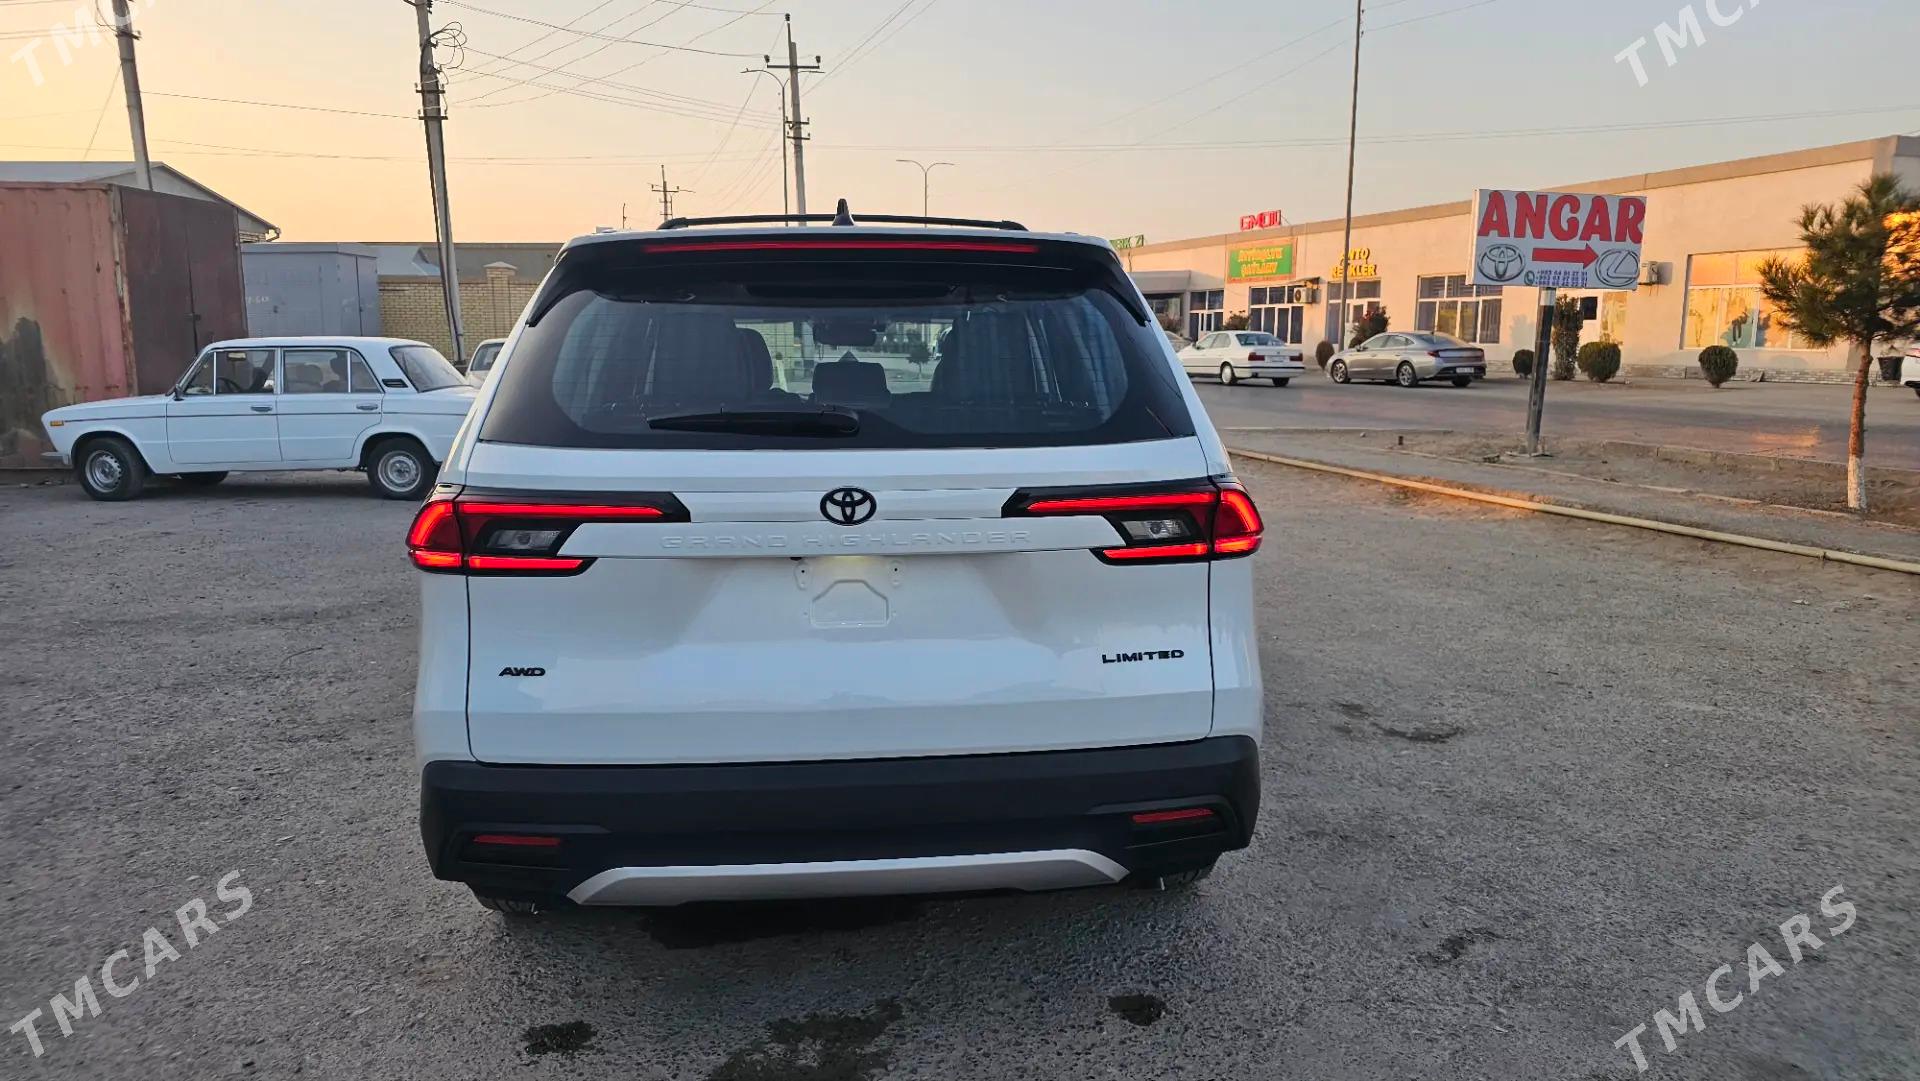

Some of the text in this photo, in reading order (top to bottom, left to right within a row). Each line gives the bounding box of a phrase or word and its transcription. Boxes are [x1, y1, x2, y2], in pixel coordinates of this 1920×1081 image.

[1477, 190, 1646, 244] ANGAR
[1332, 263, 1377, 278] REKLER
[660, 530, 1032, 550] GRAND HIGHLANDER
[1101, 649, 1184, 664] LIMITED
[498, 666, 546, 677] AWD
